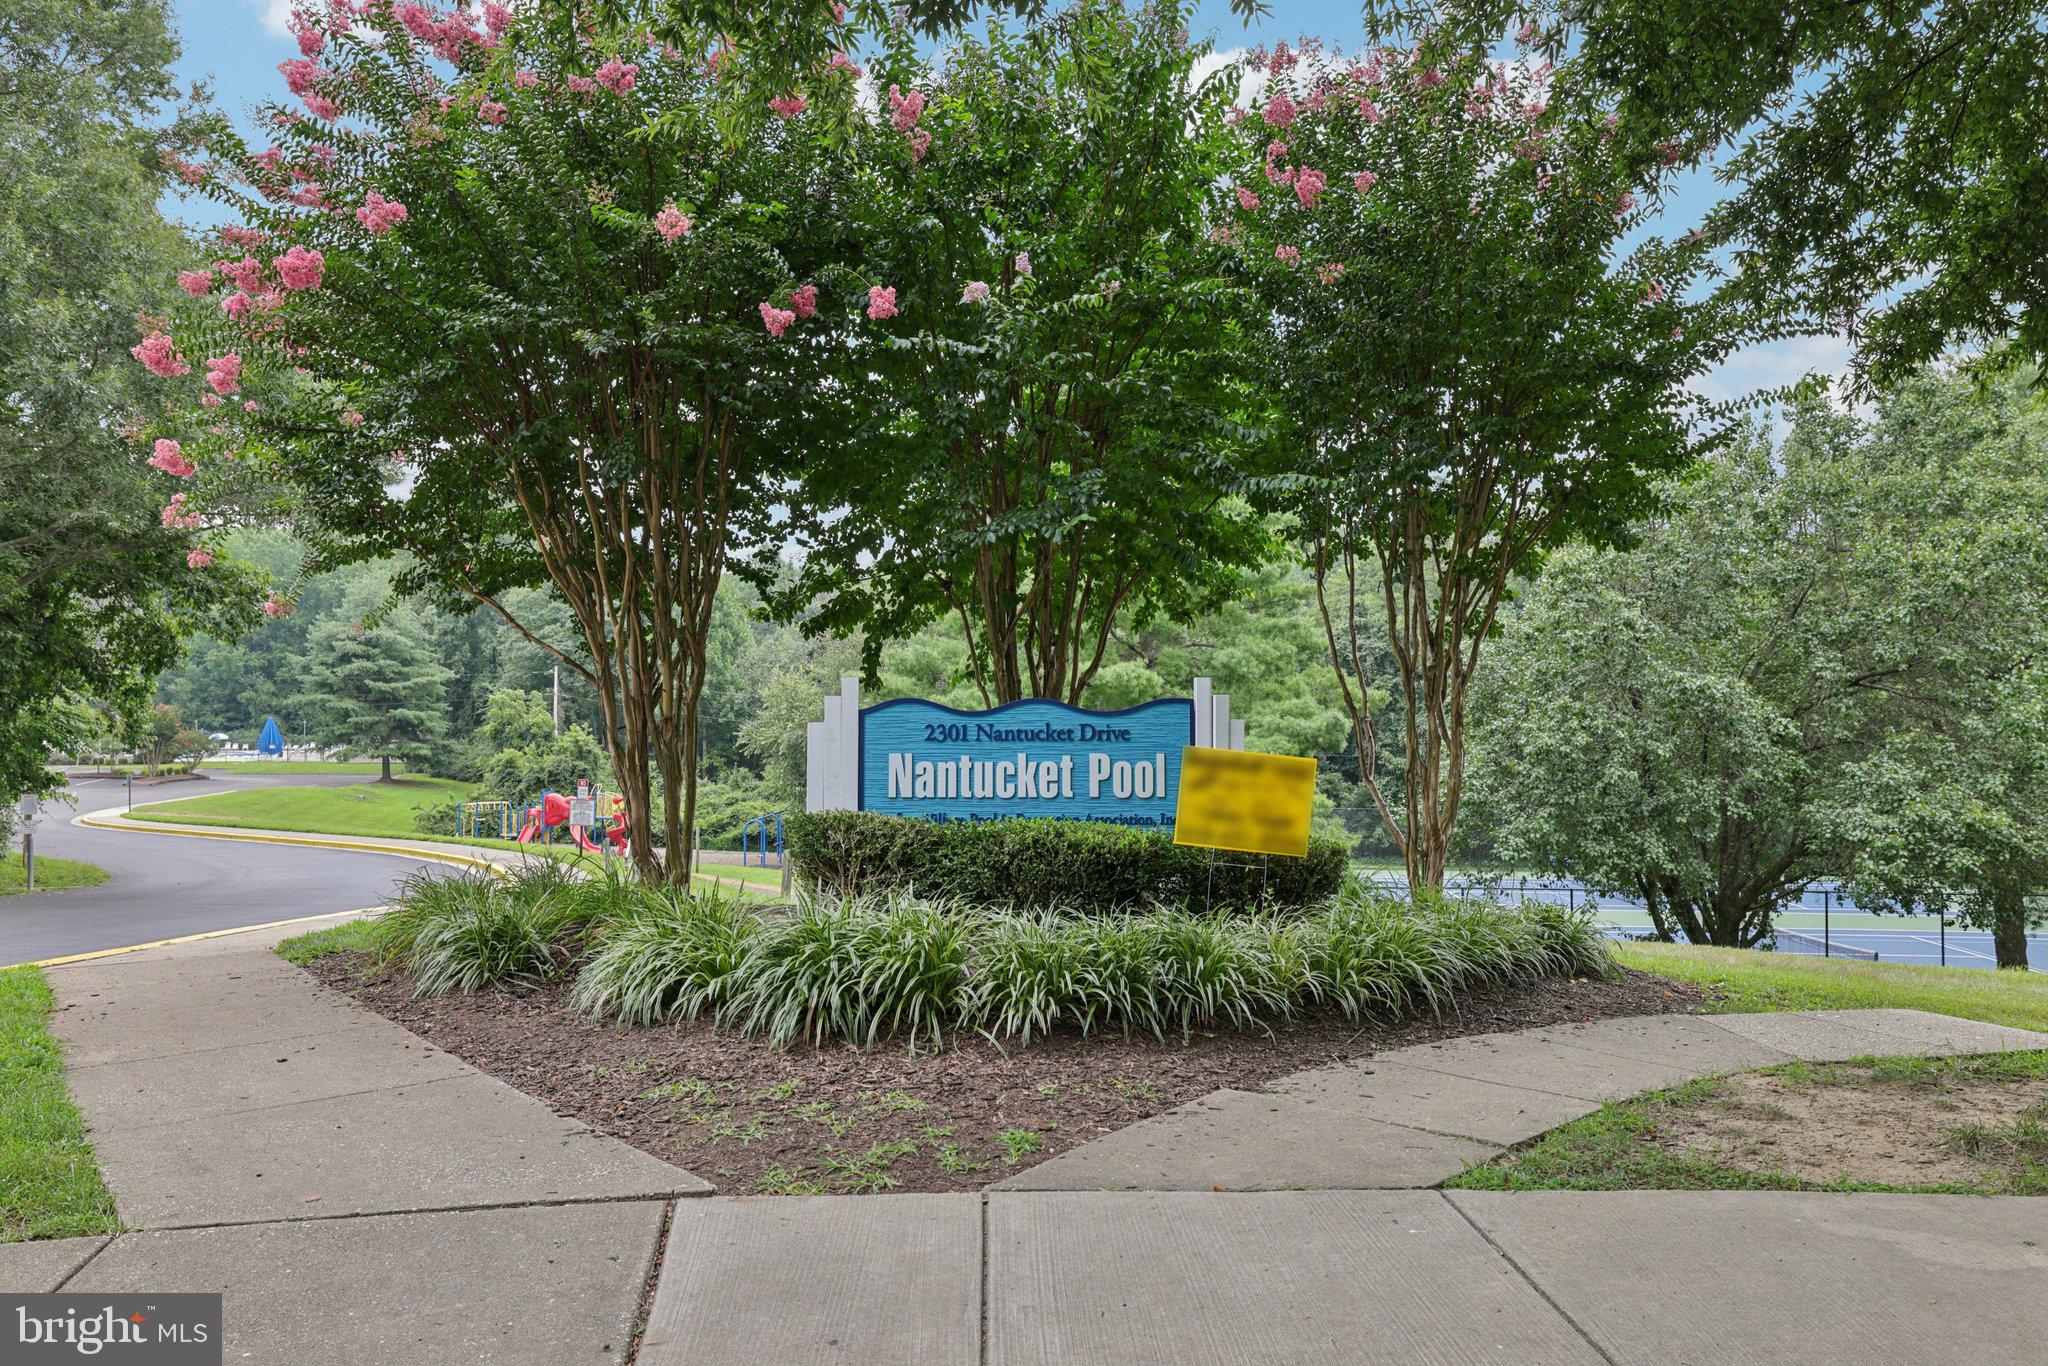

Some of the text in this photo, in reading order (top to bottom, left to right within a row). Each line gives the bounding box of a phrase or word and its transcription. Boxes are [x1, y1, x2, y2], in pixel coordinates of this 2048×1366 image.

[924, 722, 1131, 742] 2301 Nantucket Drive
[888, 752, 1166, 799] Nantucket Pool
